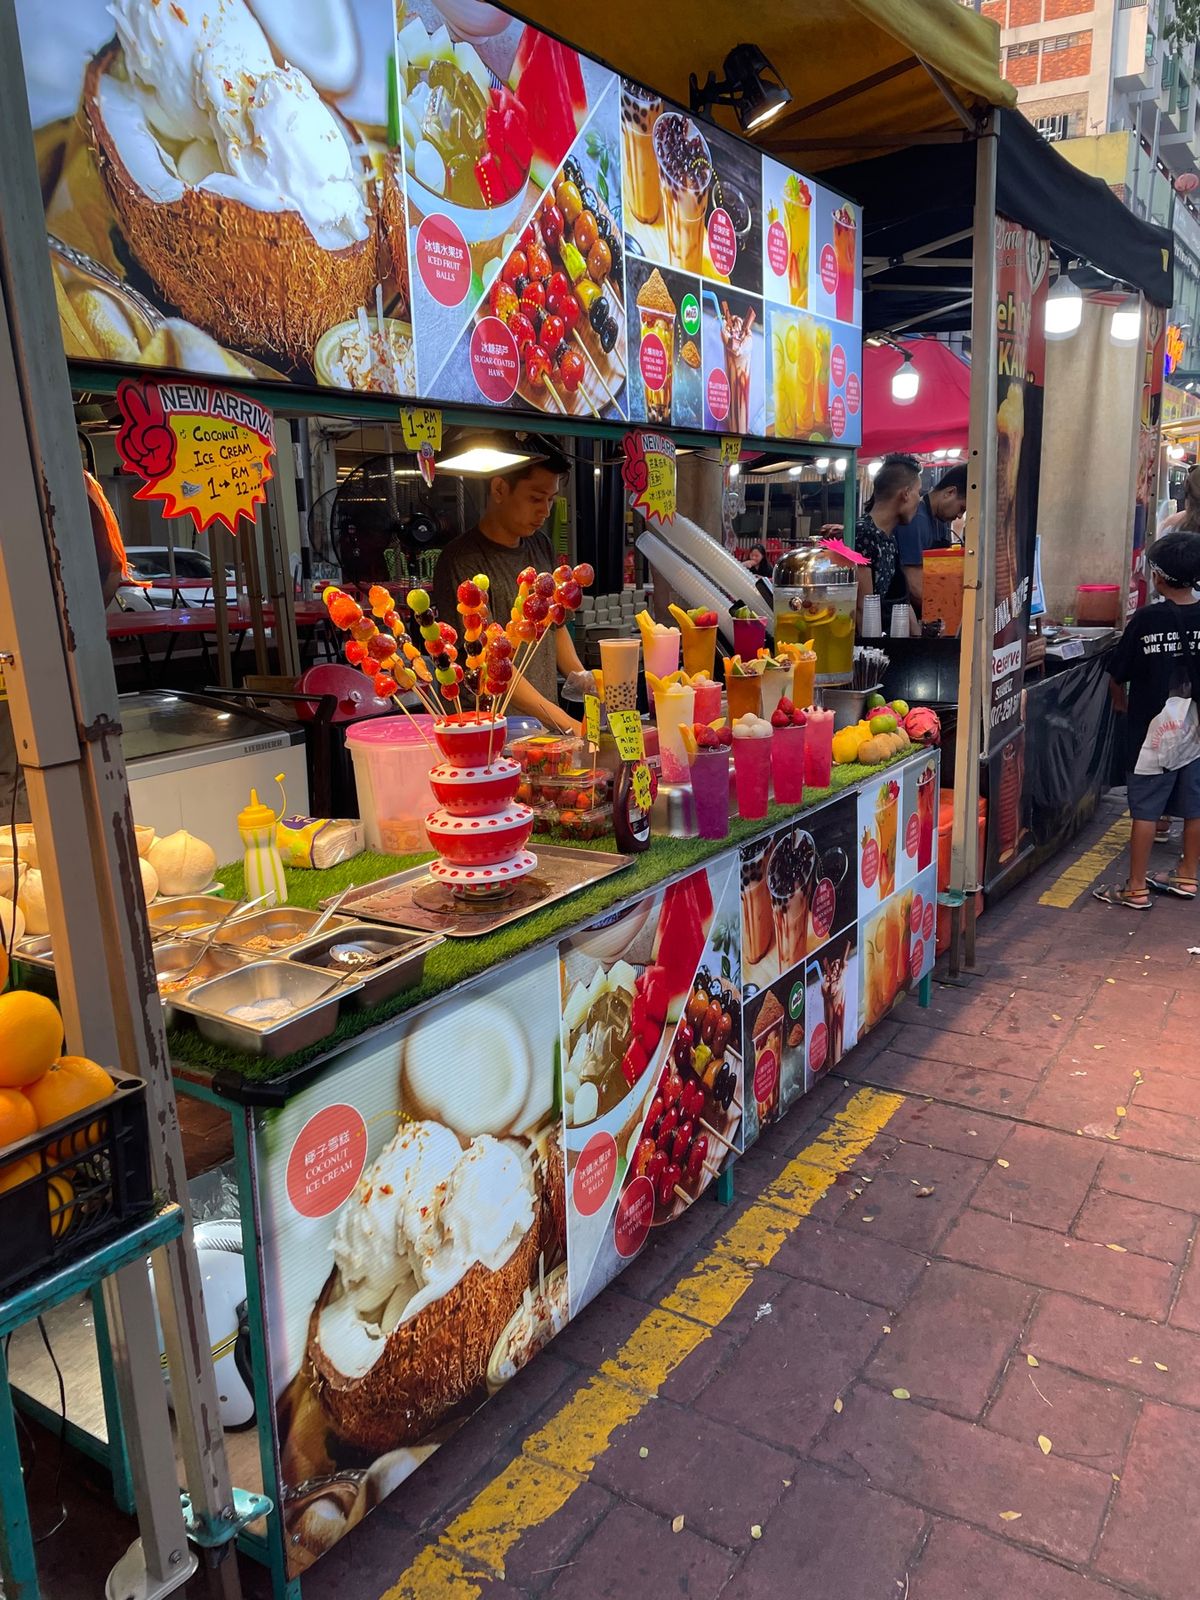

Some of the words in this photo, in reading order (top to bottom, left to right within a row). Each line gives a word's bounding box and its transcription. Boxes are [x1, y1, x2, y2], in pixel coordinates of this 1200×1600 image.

[428, 256, 442, 266] ICED
[443, 259, 460, 271] FRUIT
[436, 270, 455, 281] BALLS
[685, 308, 697, 320] MILO
[474, 355, 515, 368] SUGAR-COATED
[488, 368, 504, 377] HAWS
[158, 384, 208, 413] NEW
[424, 411, 437, 423] RM
[193, 426, 239, 442] COCONUT
[408, 414, 417, 437] 1
[427, 426, 436, 438] 12
[642, 434, 660, 451] NEW
[194, 451, 215, 467] ICE
[219, 444, 252, 460] CREAM
[231, 467, 249, 480] RM
[1163, 642, 1177, 652] THE
[992, 649, 1020, 675] Reserve
[244, 740, 282, 753] LIEBHERR
[304, 1130, 350, 1166] 椰子雪糕
[305, 1148, 349, 1180] COCONUT
[305, 1181, 321, 1195] ICE
[321, 1160, 353, 1185] CREAM
[581, 1176, 595, 1190] ICED
[594, 1163, 609, 1180] FRUIT
[588, 1178, 605, 1195] BALLS
